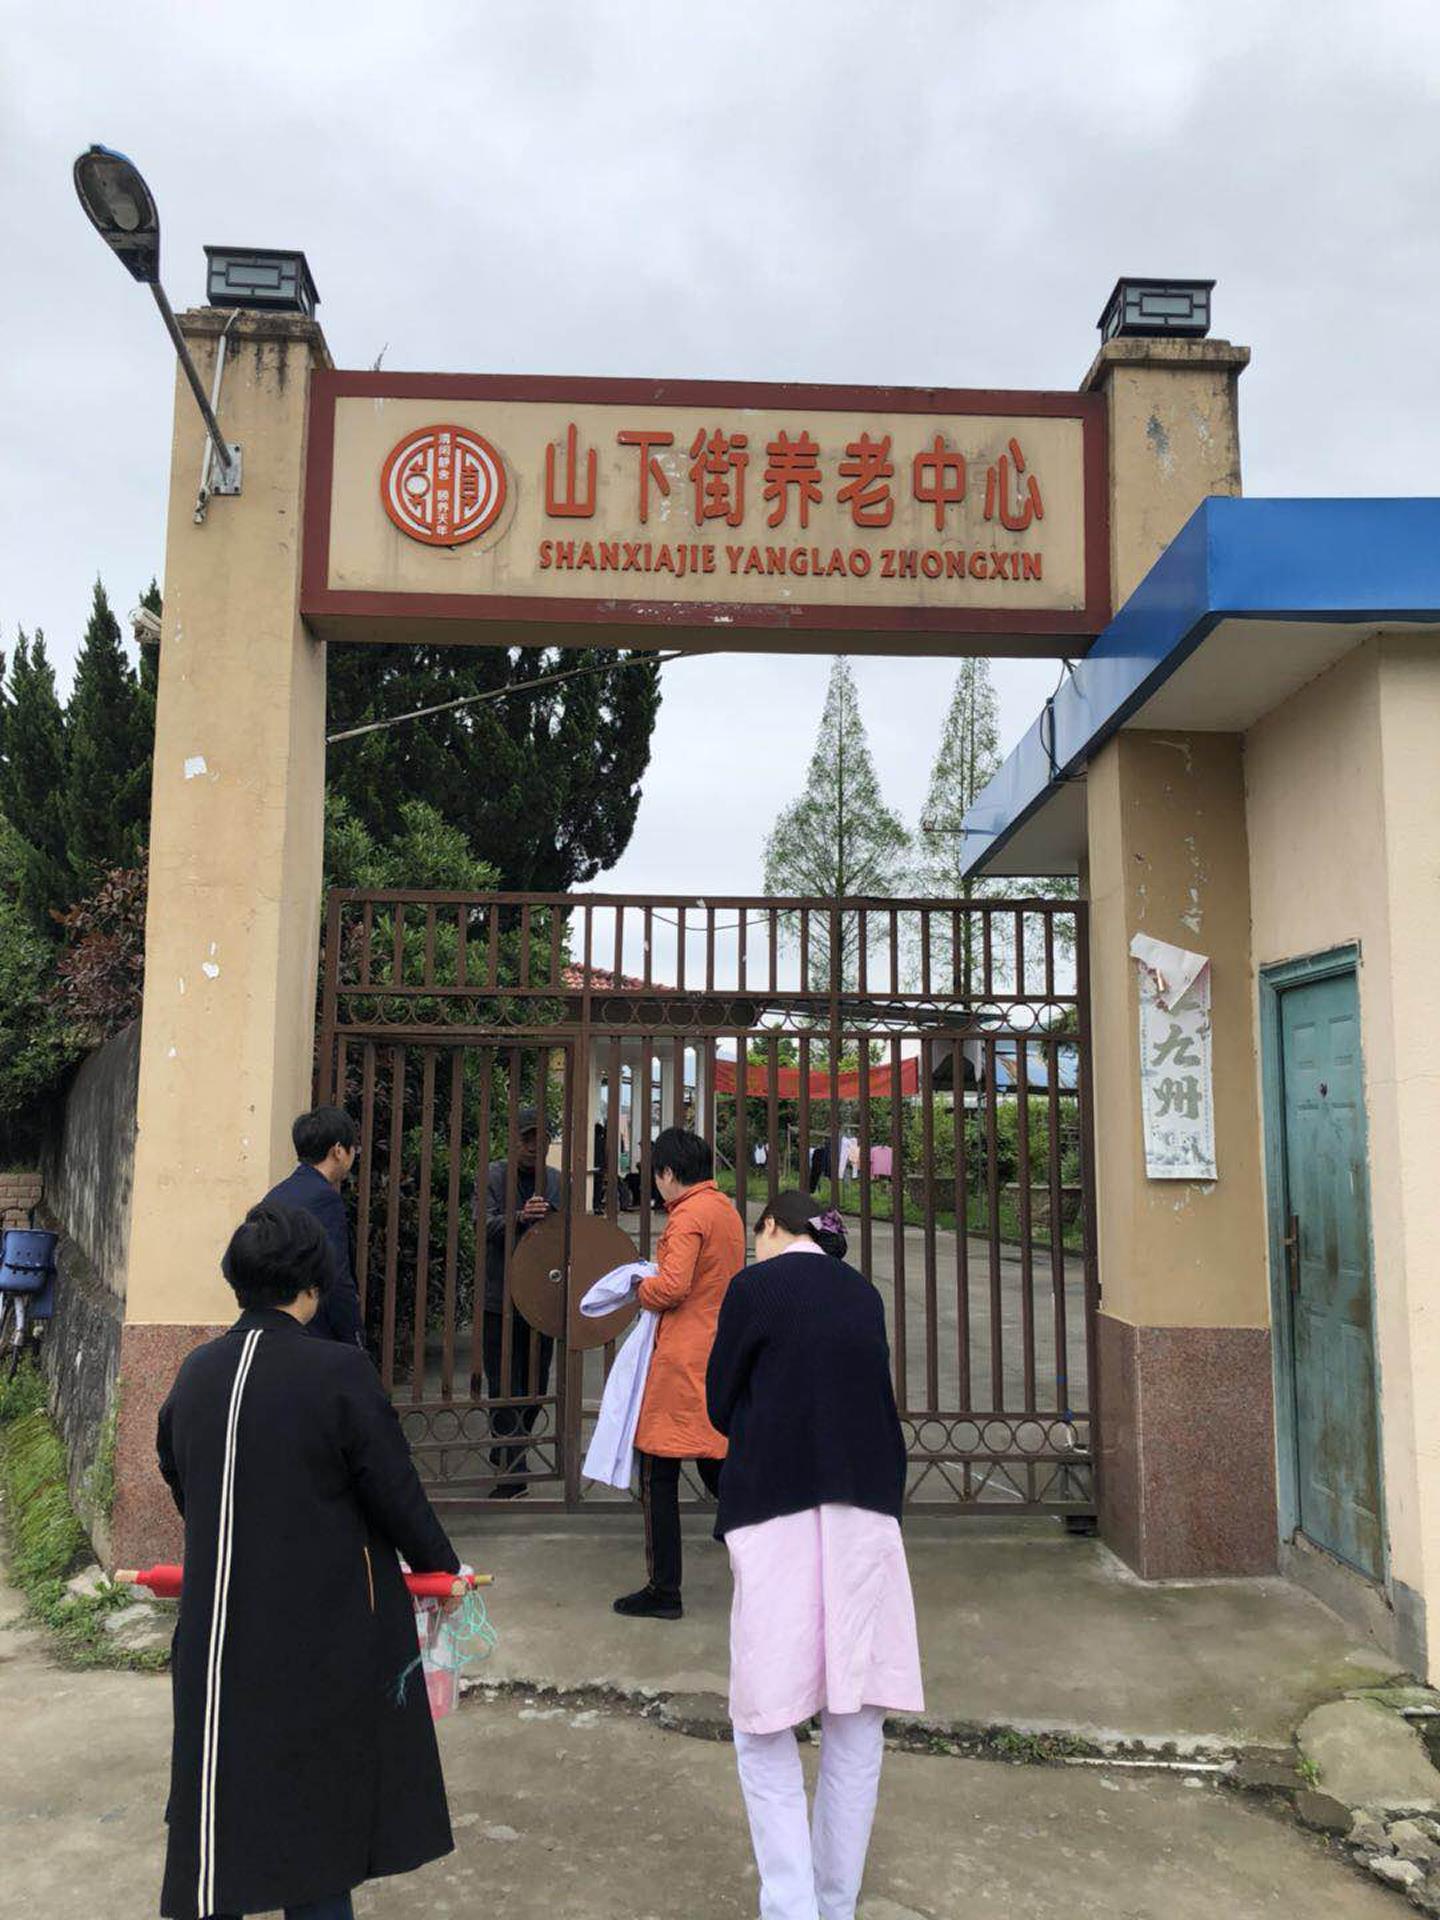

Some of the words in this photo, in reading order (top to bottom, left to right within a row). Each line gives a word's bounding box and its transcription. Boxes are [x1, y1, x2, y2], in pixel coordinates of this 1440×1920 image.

[545, 422, 1044, 531] 山下街养老中心
[539, 540, 716, 577] SHANXIAJIE
[725, 545, 872, 577] YANGLAO
[880, 548, 1042, 581] ZHONGXIN
[1152, 987, 1201, 1120] 九州
